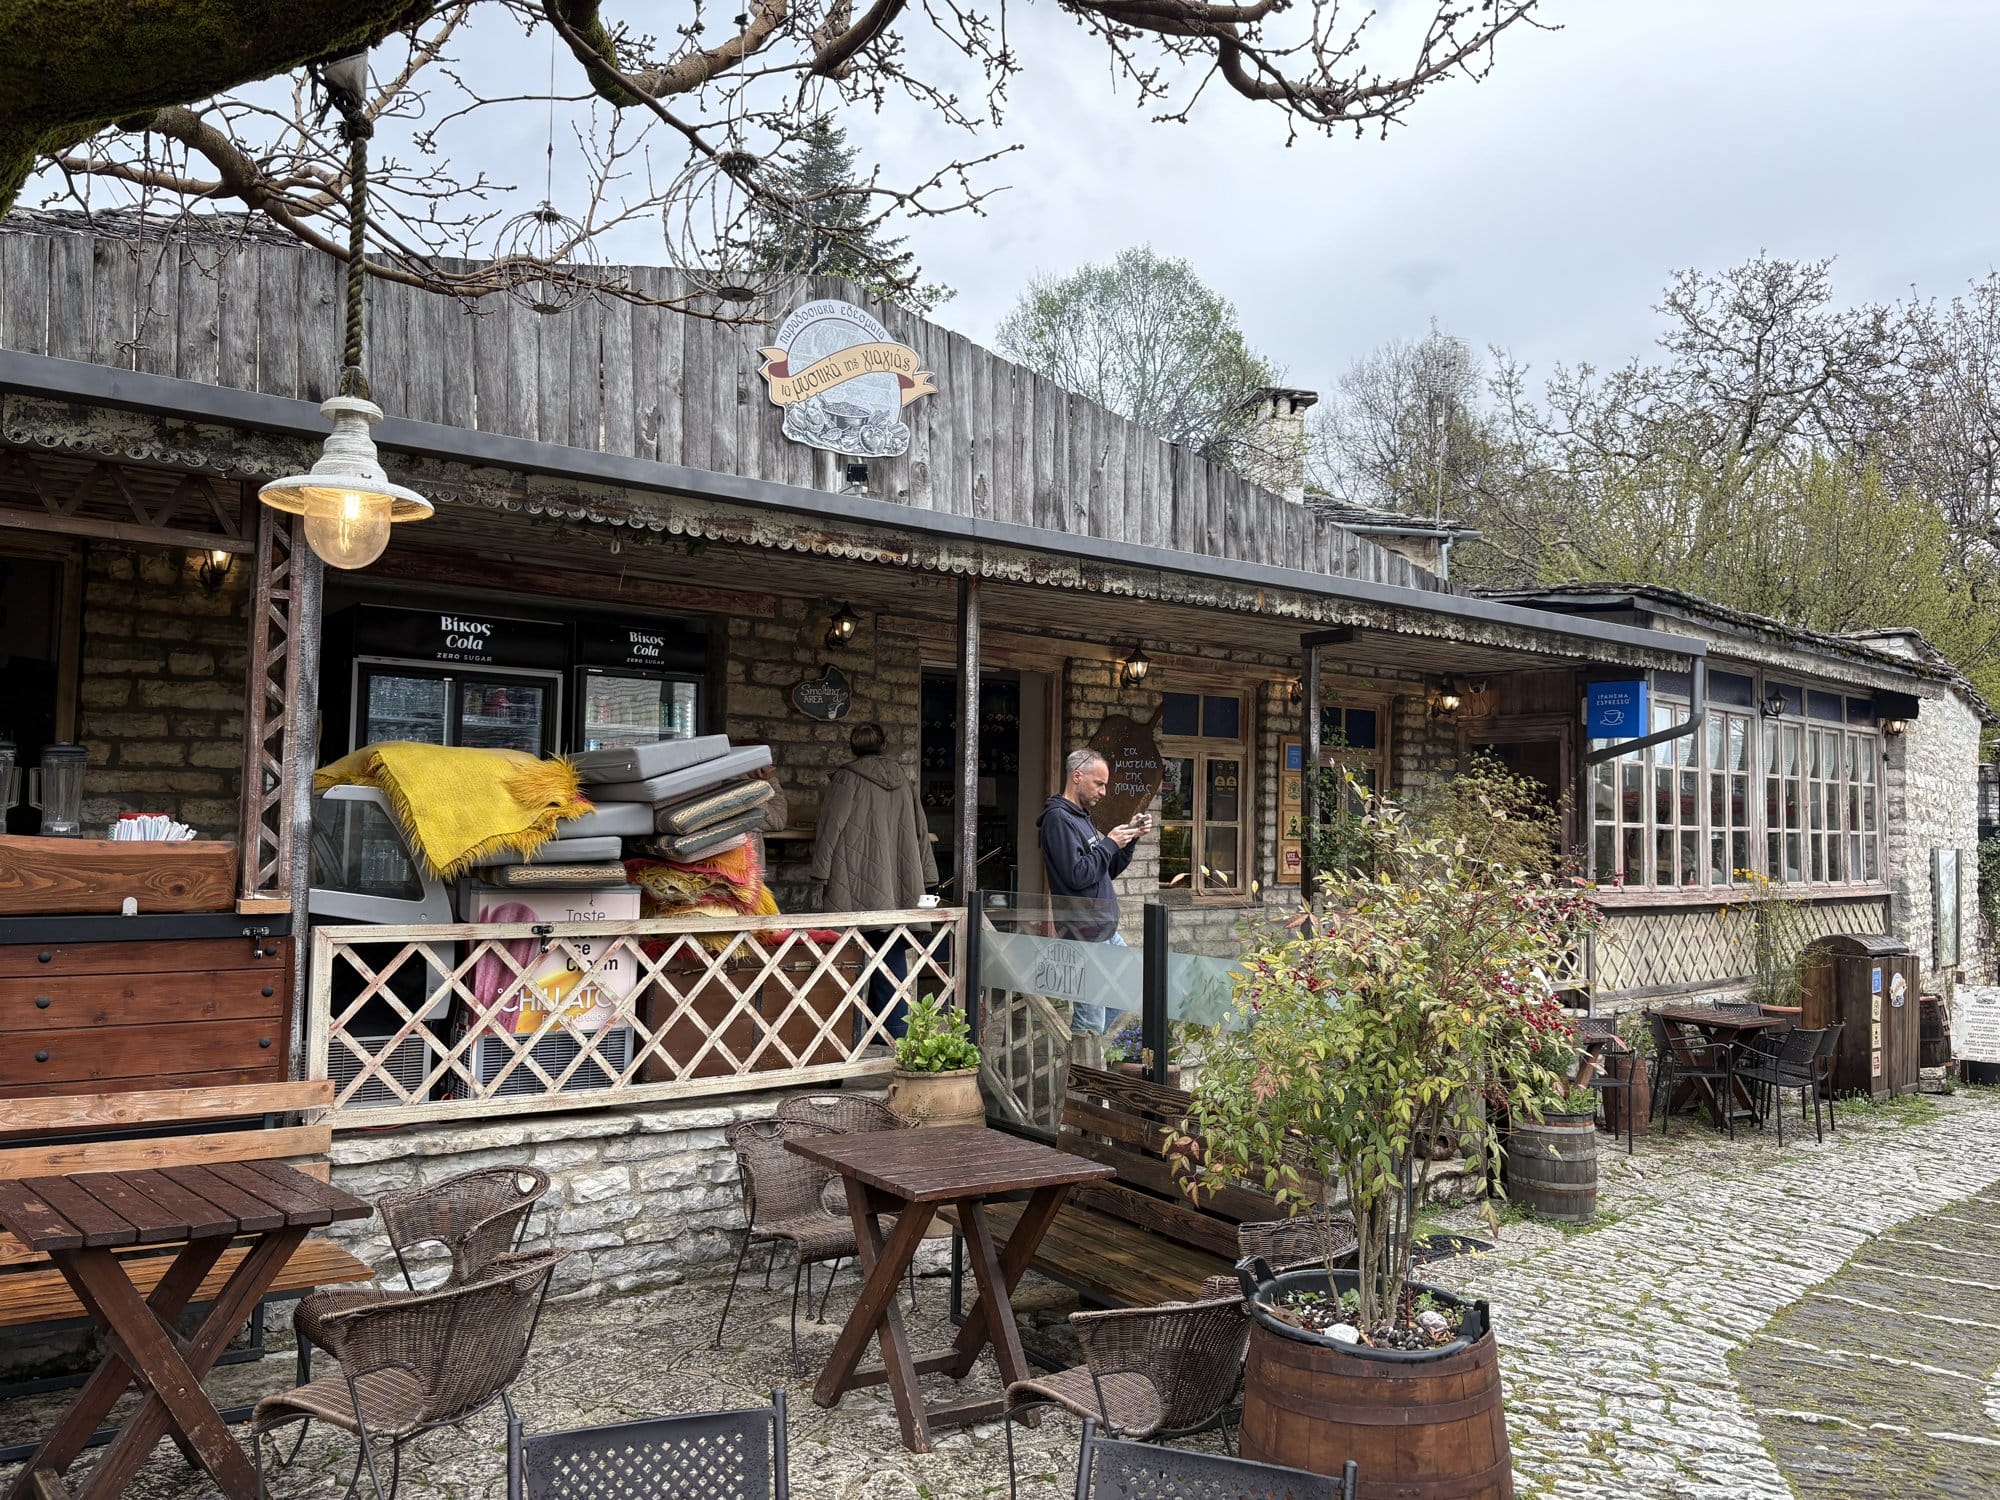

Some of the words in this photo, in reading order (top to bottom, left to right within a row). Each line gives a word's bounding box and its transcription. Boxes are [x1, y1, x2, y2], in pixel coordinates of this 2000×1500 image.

[780, 301, 835, 344] παραδοσιακά
[840, 304, 885, 340] εδέσματα
[791, 357, 842, 401] μυστικά
[861, 348, 911, 373] γιαγιάς
[440, 615, 492, 637] Βίκος
[446, 634, 484, 651] Cola
[436, 652, 460, 660] ZERO
[463, 654, 493, 662] SUGAR
[633, 644, 660, 657] Cola
[800, 683, 842, 702] Smoking
[803, 695, 823, 703] AREA
[1123, 747, 1138, 757] τα
[1125, 771, 1142, 784] της
[566, 909, 606, 921] Taste
